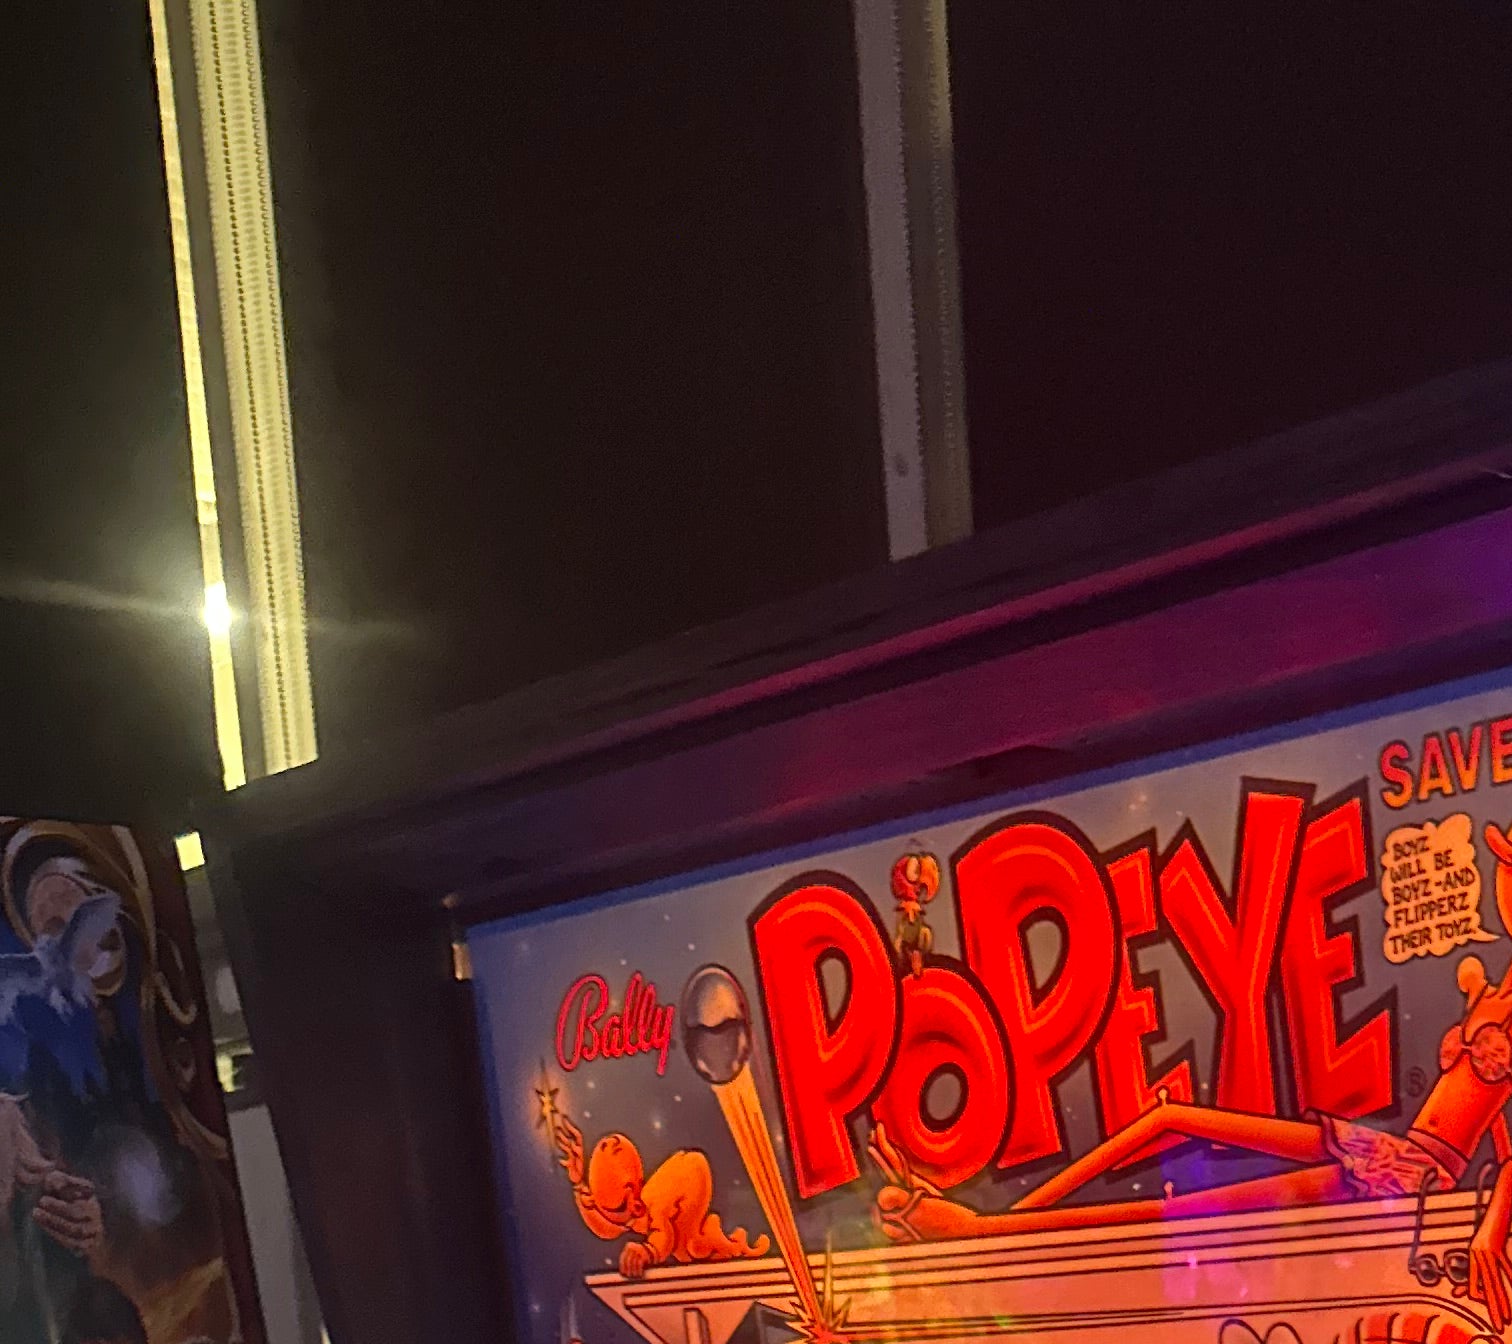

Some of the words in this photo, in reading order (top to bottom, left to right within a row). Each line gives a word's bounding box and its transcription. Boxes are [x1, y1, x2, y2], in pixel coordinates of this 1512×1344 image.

[1390, 859, 1427, 884] WILL
[1434, 849, 1454, 871] BE
[1393, 836, 1430, 862] BOYZ
[1392, 878, 1431, 905] BOYZ
[1393, 891, 1470, 929] FLIPPERZ
[1389, 926, 1433, 954] THEIR
[747, 777, 1398, 1208] POPEYE
[556, 970, 675, 1076] Bally
